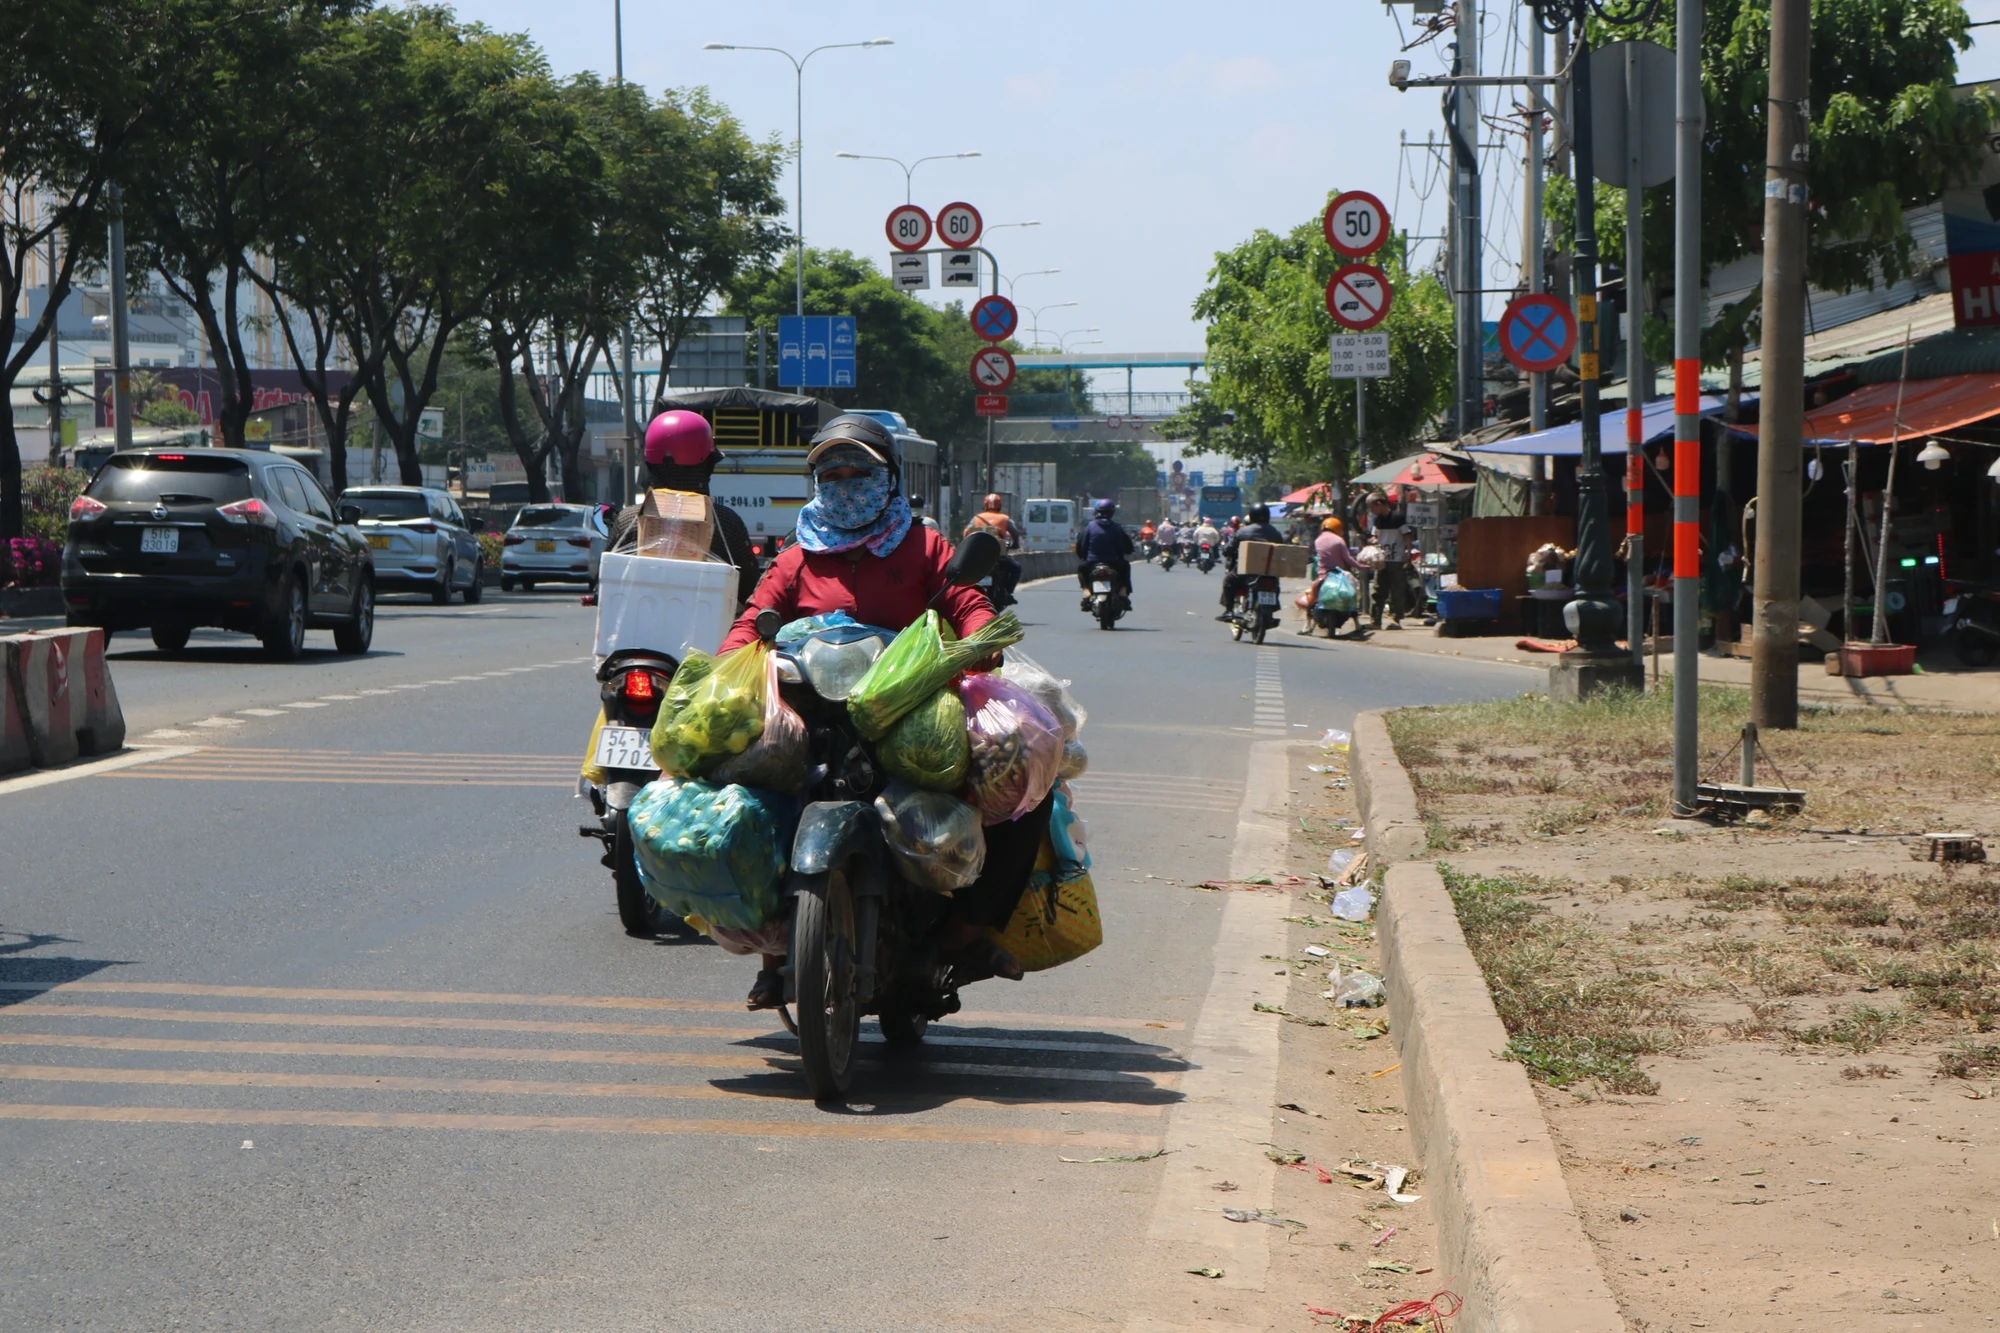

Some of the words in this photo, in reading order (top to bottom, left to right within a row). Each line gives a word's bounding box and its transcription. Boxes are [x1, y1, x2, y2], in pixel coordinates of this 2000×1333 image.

[899, 219, 919, 238] 80
[949, 215, 969, 234] 60
[1345, 210, 1371, 237] 50
[151, 529, 171, 539] 51G
[607, 730, 652, 749] 54-V
[606, 748, 653, 767] 1702
